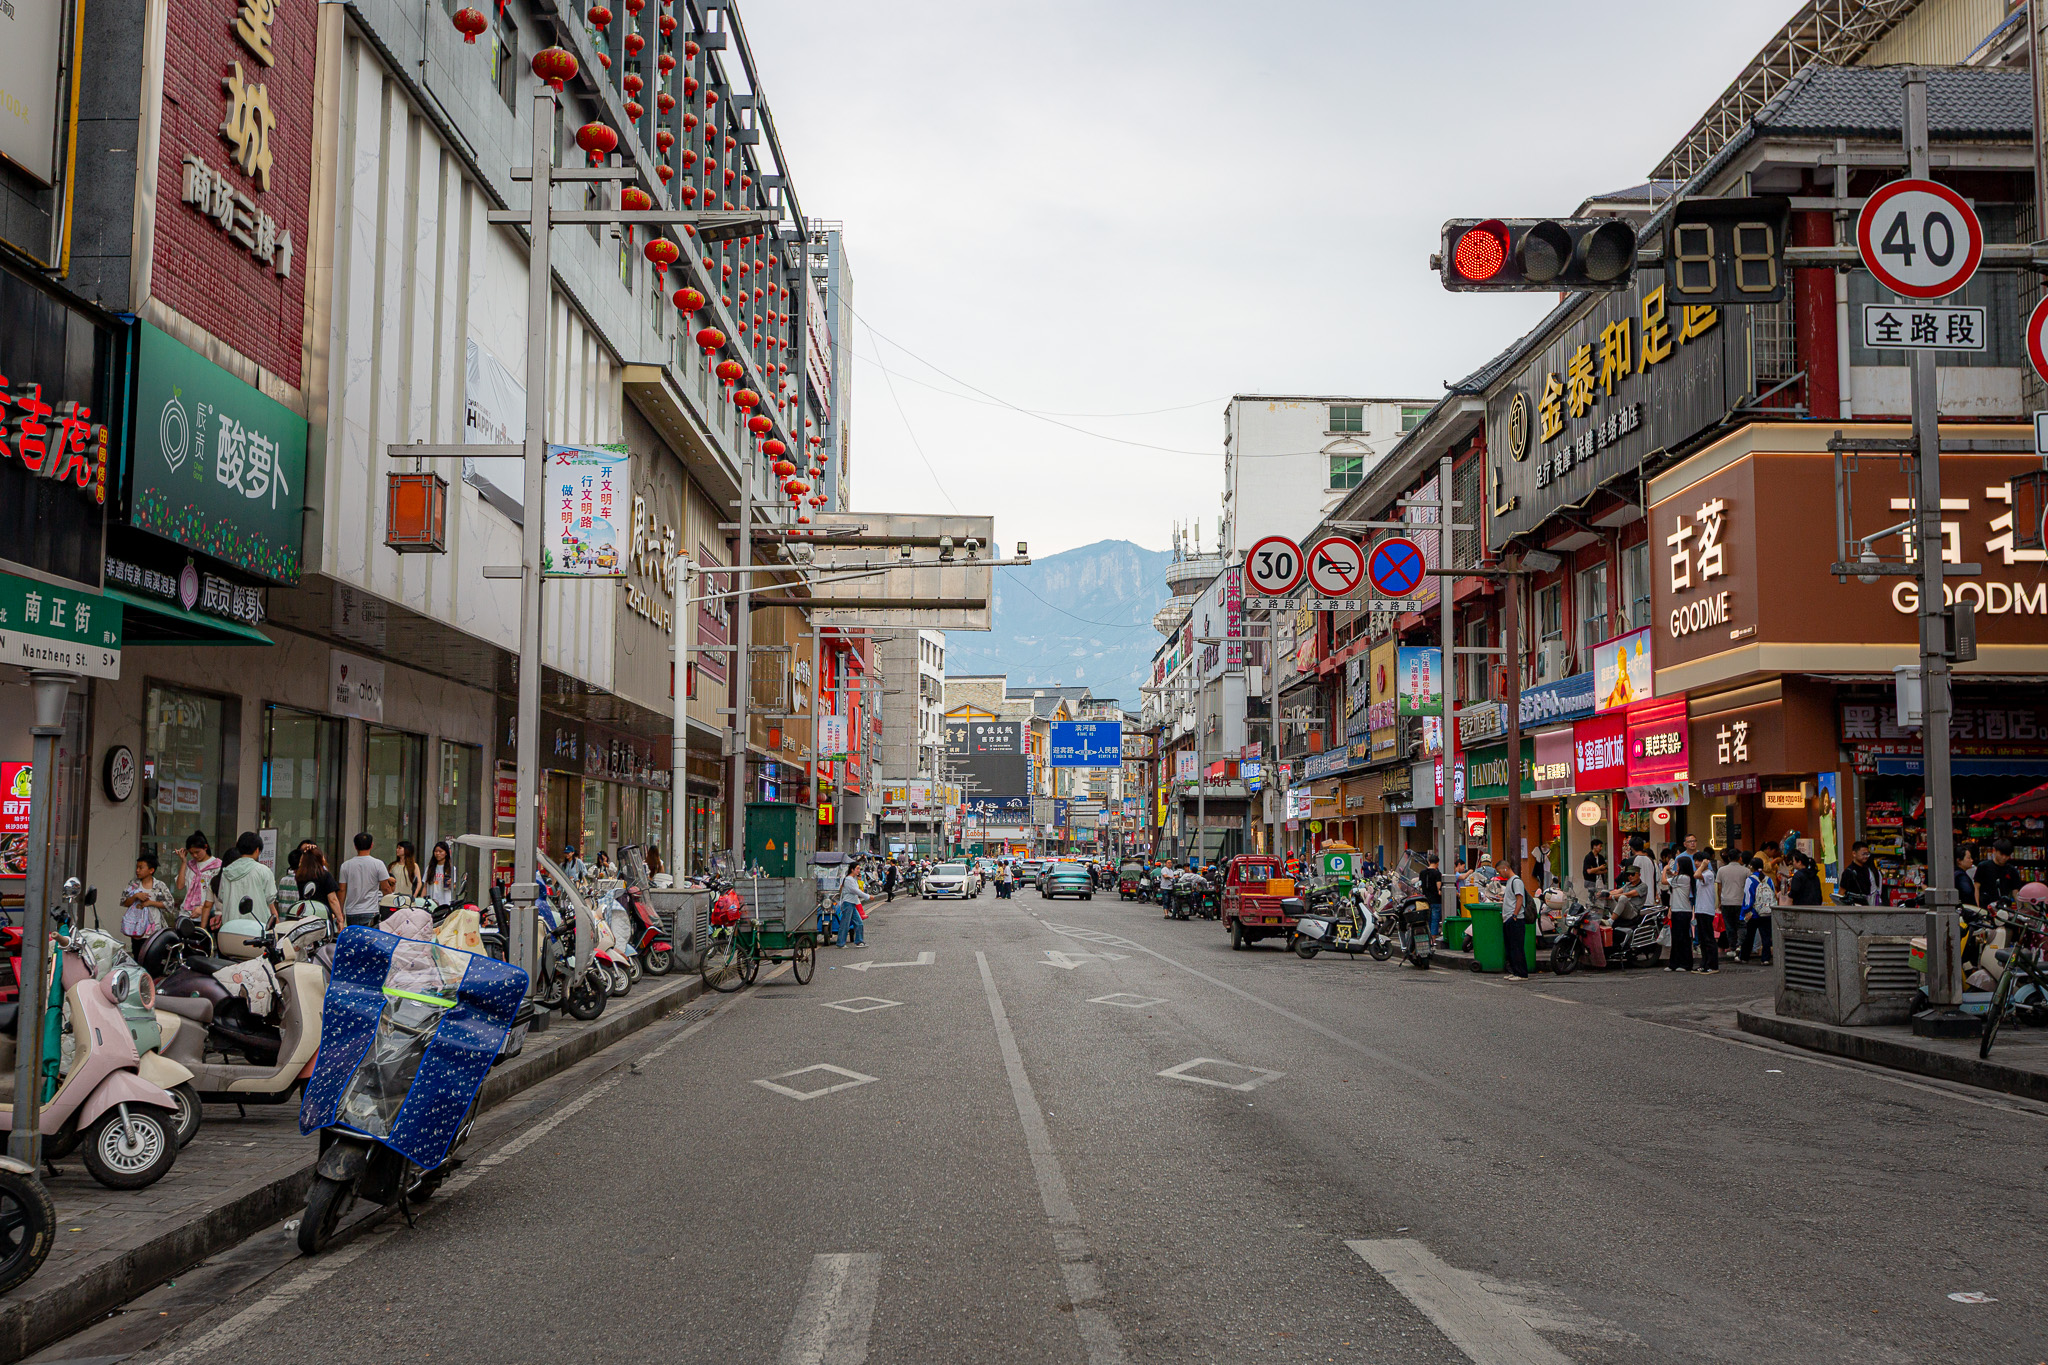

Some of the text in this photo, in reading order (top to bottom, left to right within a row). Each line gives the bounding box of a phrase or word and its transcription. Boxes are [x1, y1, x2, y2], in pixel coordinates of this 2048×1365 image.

[182, 152, 277, 267] 商场三楼
[1880, 211, 1955, 267] 40
[1874, 312, 1976, 344] 全路段
[1554, 445, 1572, 478] 按摩
[1576, 428, 1595, 463] 保健
[1597, 412, 1618, 449] 经络
[1618, 401, 1642, 437] 油压
[216, 413, 289, 511] 酸萝卜
[556, 451, 579, 466] 文明
[580, 475, 594, 529] 行文明路
[600, 466, 613, 519] 开文明车
[561, 484, 574, 537] 做文明人
[1666, 497, 1724, 594] 古茗
[1257, 551, 1293, 580] 30
[25, 590, 92, 634] 南正街
[103, 631, 111, 644] 南
[1252, 599, 1295, 610] 全路段
[1313, 600, 1356, 611] 全路段
[1374, 601, 1416, 612] 全路段
[1670, 590, 1729, 639] GOODME
[23, 643, 70, 668] Nanzheng
[76, 652, 88, 667] St.
[102, 653, 108, 666] S
[1228, 646, 1242, 656] 3F
[337, 684, 350, 696] HAPPY
[359, 679, 382, 701] aloof
[1422, 652, 1431, 704] 卫生健康你我他
[1075, 724, 1097, 732] 滨河路
[1843, 706, 2037, 740] 黑鲨竞酒店
[1098, 746, 1119, 754] 人民路
[1585, 734, 1625, 771] 蜜雪冰城
[1645, 733, 1668, 757] 果芭芙
[1668, 742, 1682, 754] BUFF
[1716, 720, 1748, 765] 古茗
[1471, 758, 1510, 787] HANDBOO
